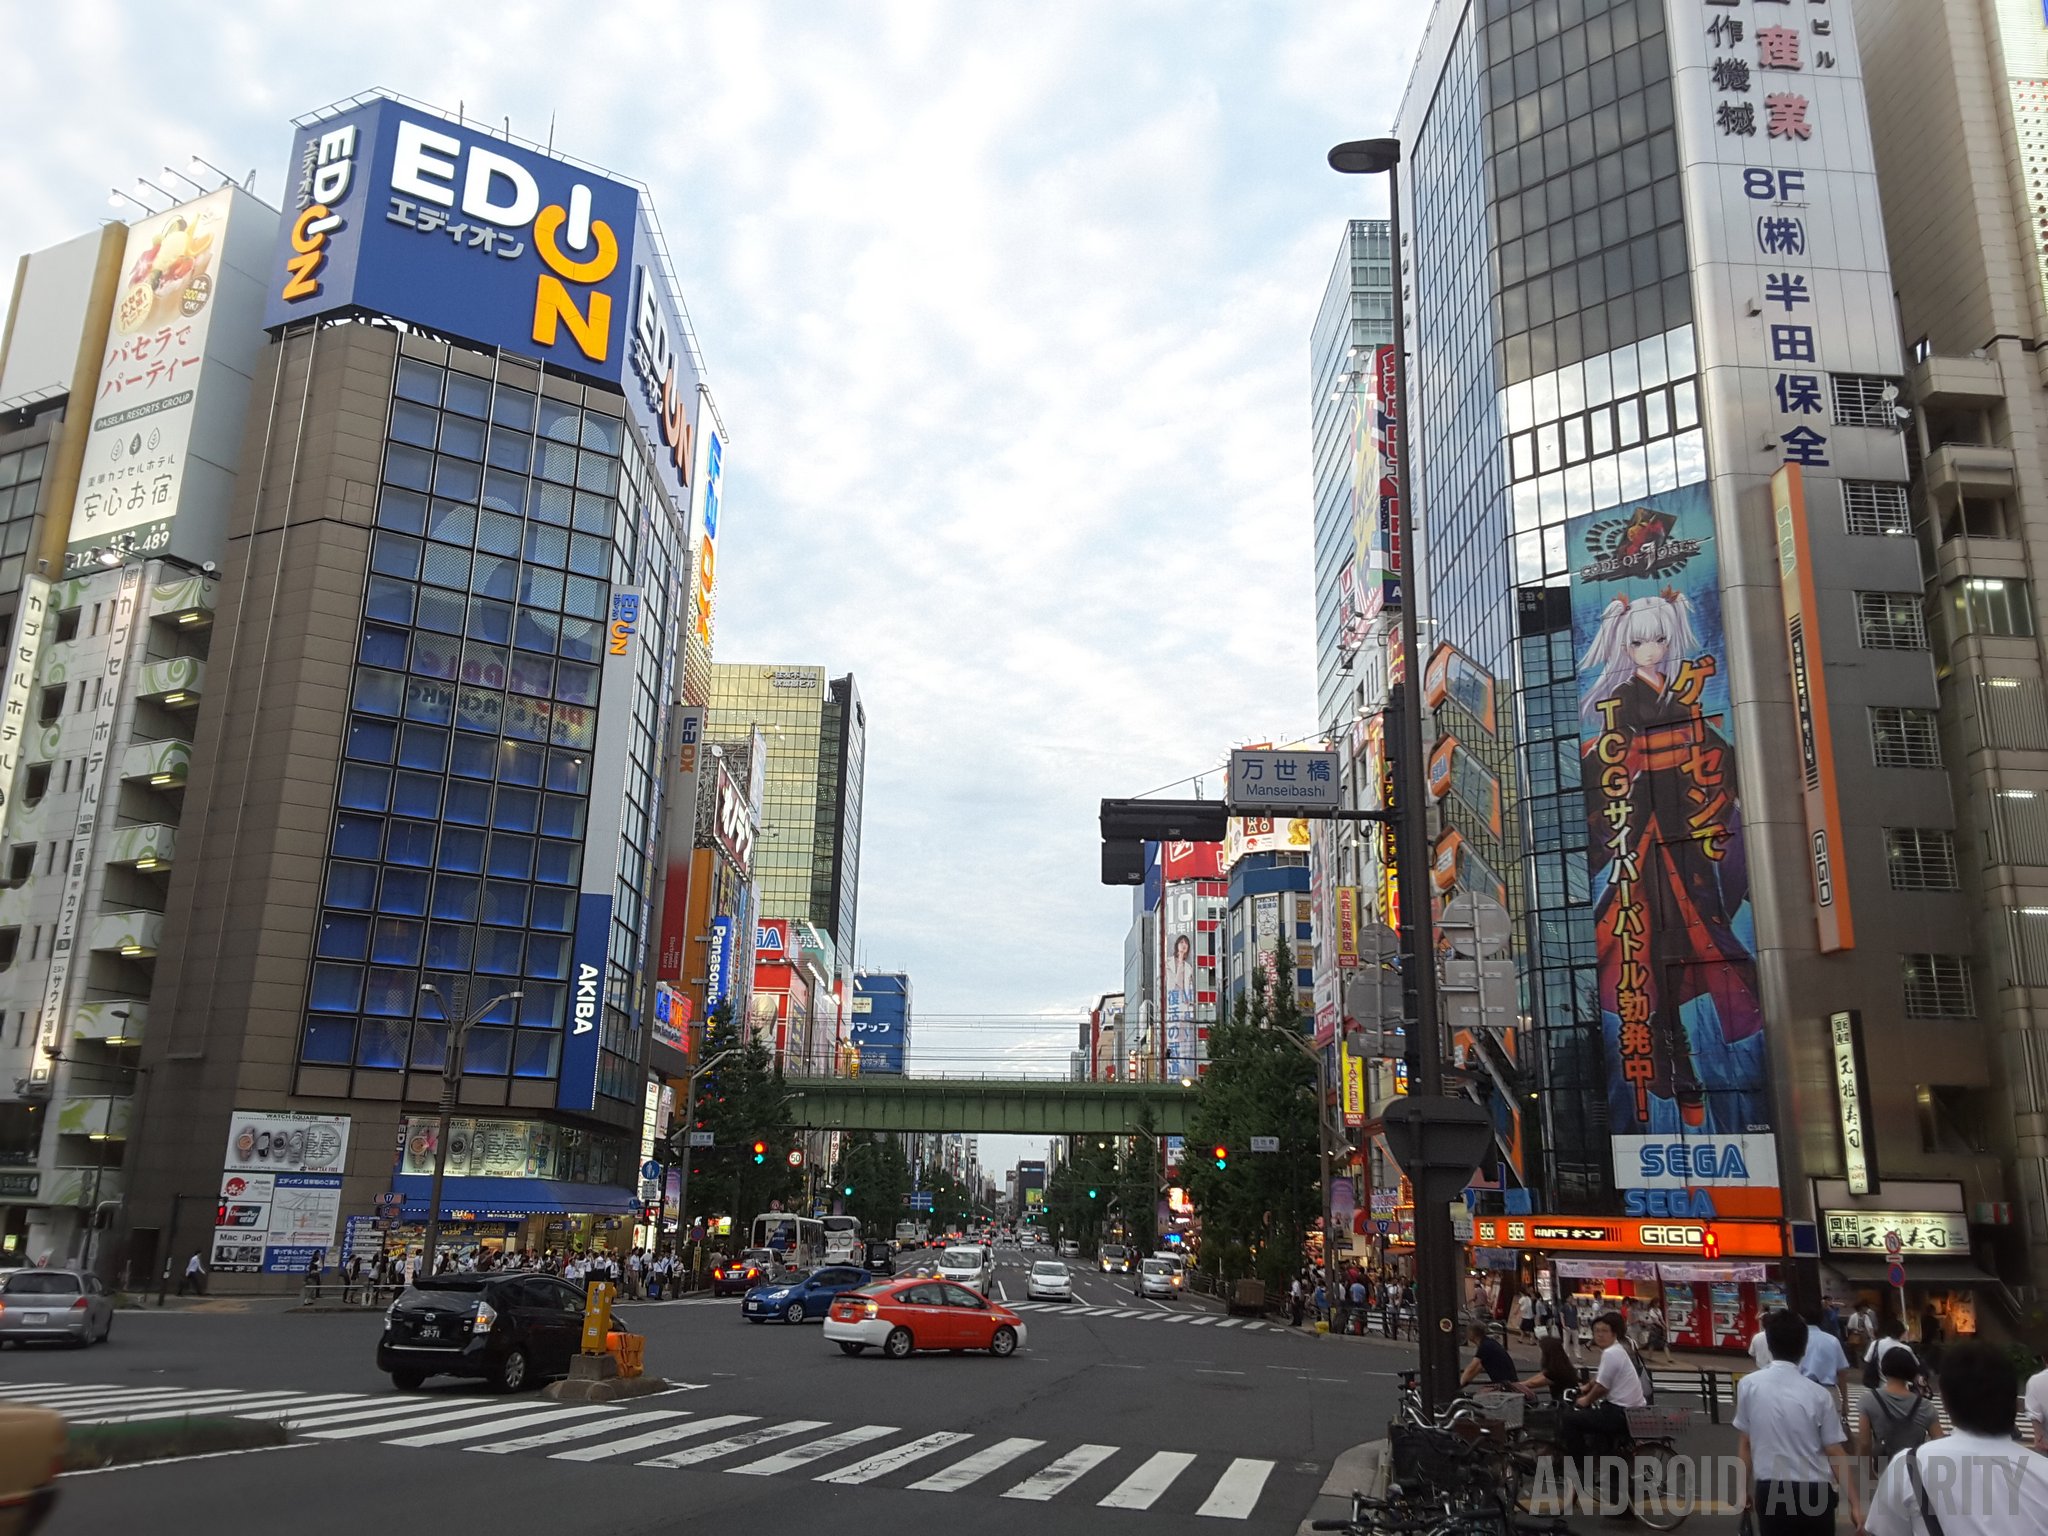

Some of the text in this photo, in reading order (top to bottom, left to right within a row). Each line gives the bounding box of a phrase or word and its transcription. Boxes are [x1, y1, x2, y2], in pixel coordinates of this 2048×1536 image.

[1808, 0, 1836, 68] ビル
[1704, 0, 1757, 137] 作機械
[1753, 0, 1812, 141] 産業
[1742, 168, 1806, 202] 8F
[282, 124, 358, 302] EDION
[386, 197, 525, 260] エディオン
[390, 119, 620, 362] EDION
[106, 325, 192, 369] パセラで
[101, 356, 200, 398] パーティー
[637, 264, 694, 488] EDION
[97, 393, 190, 430] PASELA RESORTS GROUP
[84, 473, 172, 522] 安心お宿
[1580, 557, 1621, 578] CODE
[1622, 552, 1642, 568] OF
[609, 593, 640, 656] EDION
[0, 595, 43, 771] カプセルホテル
[84, 596, 132, 804] カプセルホテル
[1241, 759, 1331, 782] 万世橋
[1670, 655, 1728, 862] ゲーセンで
[1246, 783, 1325, 798] Manseibashi
[1167, 886, 1193, 896] デビュー
[1167, 893, 1193, 924] 10
[62, 893, 77, 936] カフェ
[708, 925, 726, 1005] Panasonic
[573, 963, 598, 1035] AKIBA
[1168, 990, 1181, 1083] 復活の武道
[1348, 1061, 1357, 1082] TAX
[790, 1153, 801, 1162] 50
[1640, 1144, 1750, 1178] SEGA
[385, 1194, 393, 1202] 17
[1624, 1188, 1717, 1218] SEGA
[219, 1233, 262, 1242] Mac iPad
[1640, 1225, 1706, 1247] GiGO
